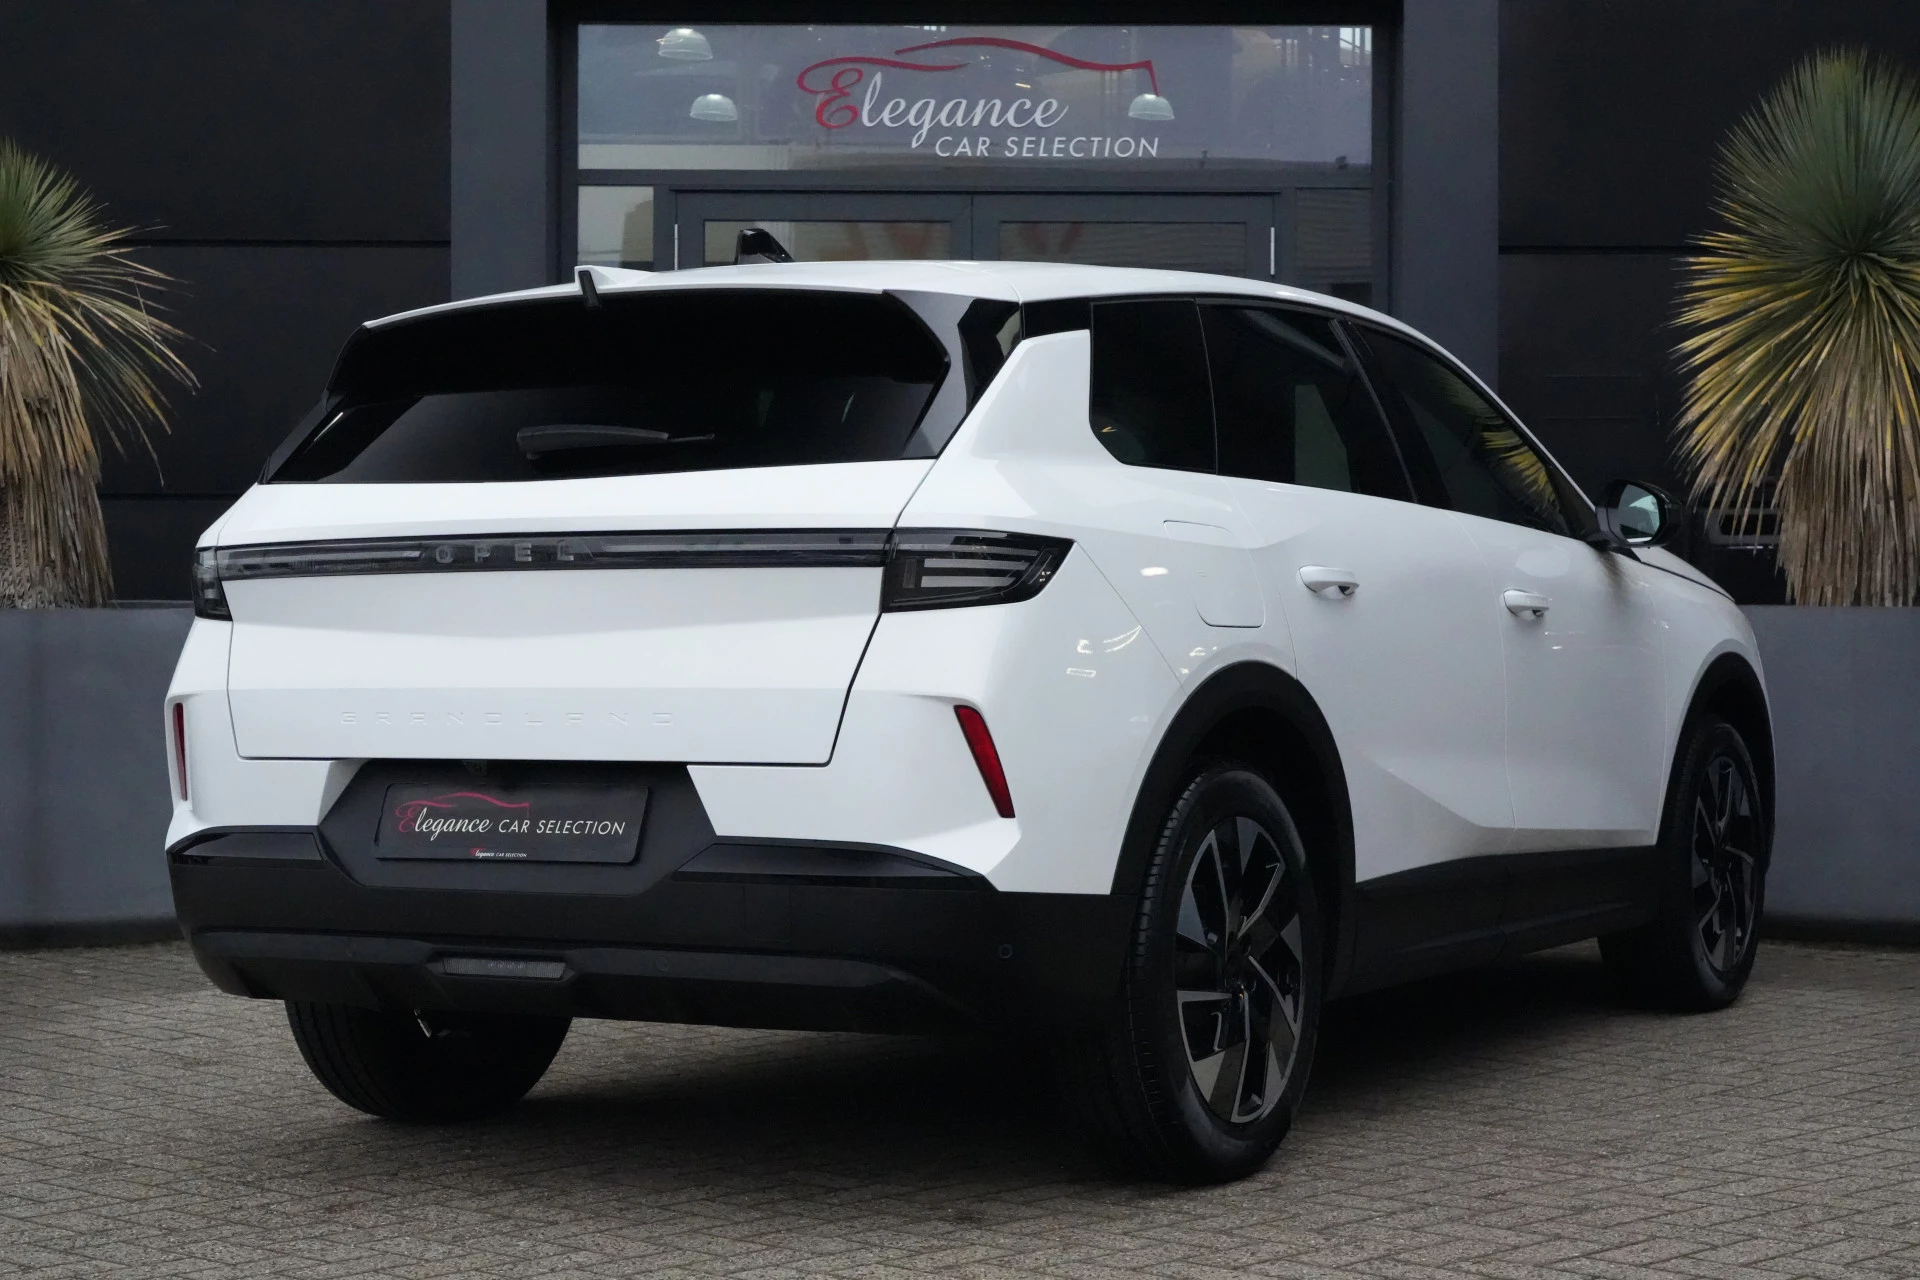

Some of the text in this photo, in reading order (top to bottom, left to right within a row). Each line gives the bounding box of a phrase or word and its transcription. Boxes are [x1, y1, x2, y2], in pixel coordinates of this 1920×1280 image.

[797, 67, 1069, 149] Elegance
[935, 136, 1160, 158] CAR SELECTION
[435, 540, 575, 564] OPEL
[396, 804, 626, 841] Elegance CAR SELECTION
[470, 848, 495, 859] legance
